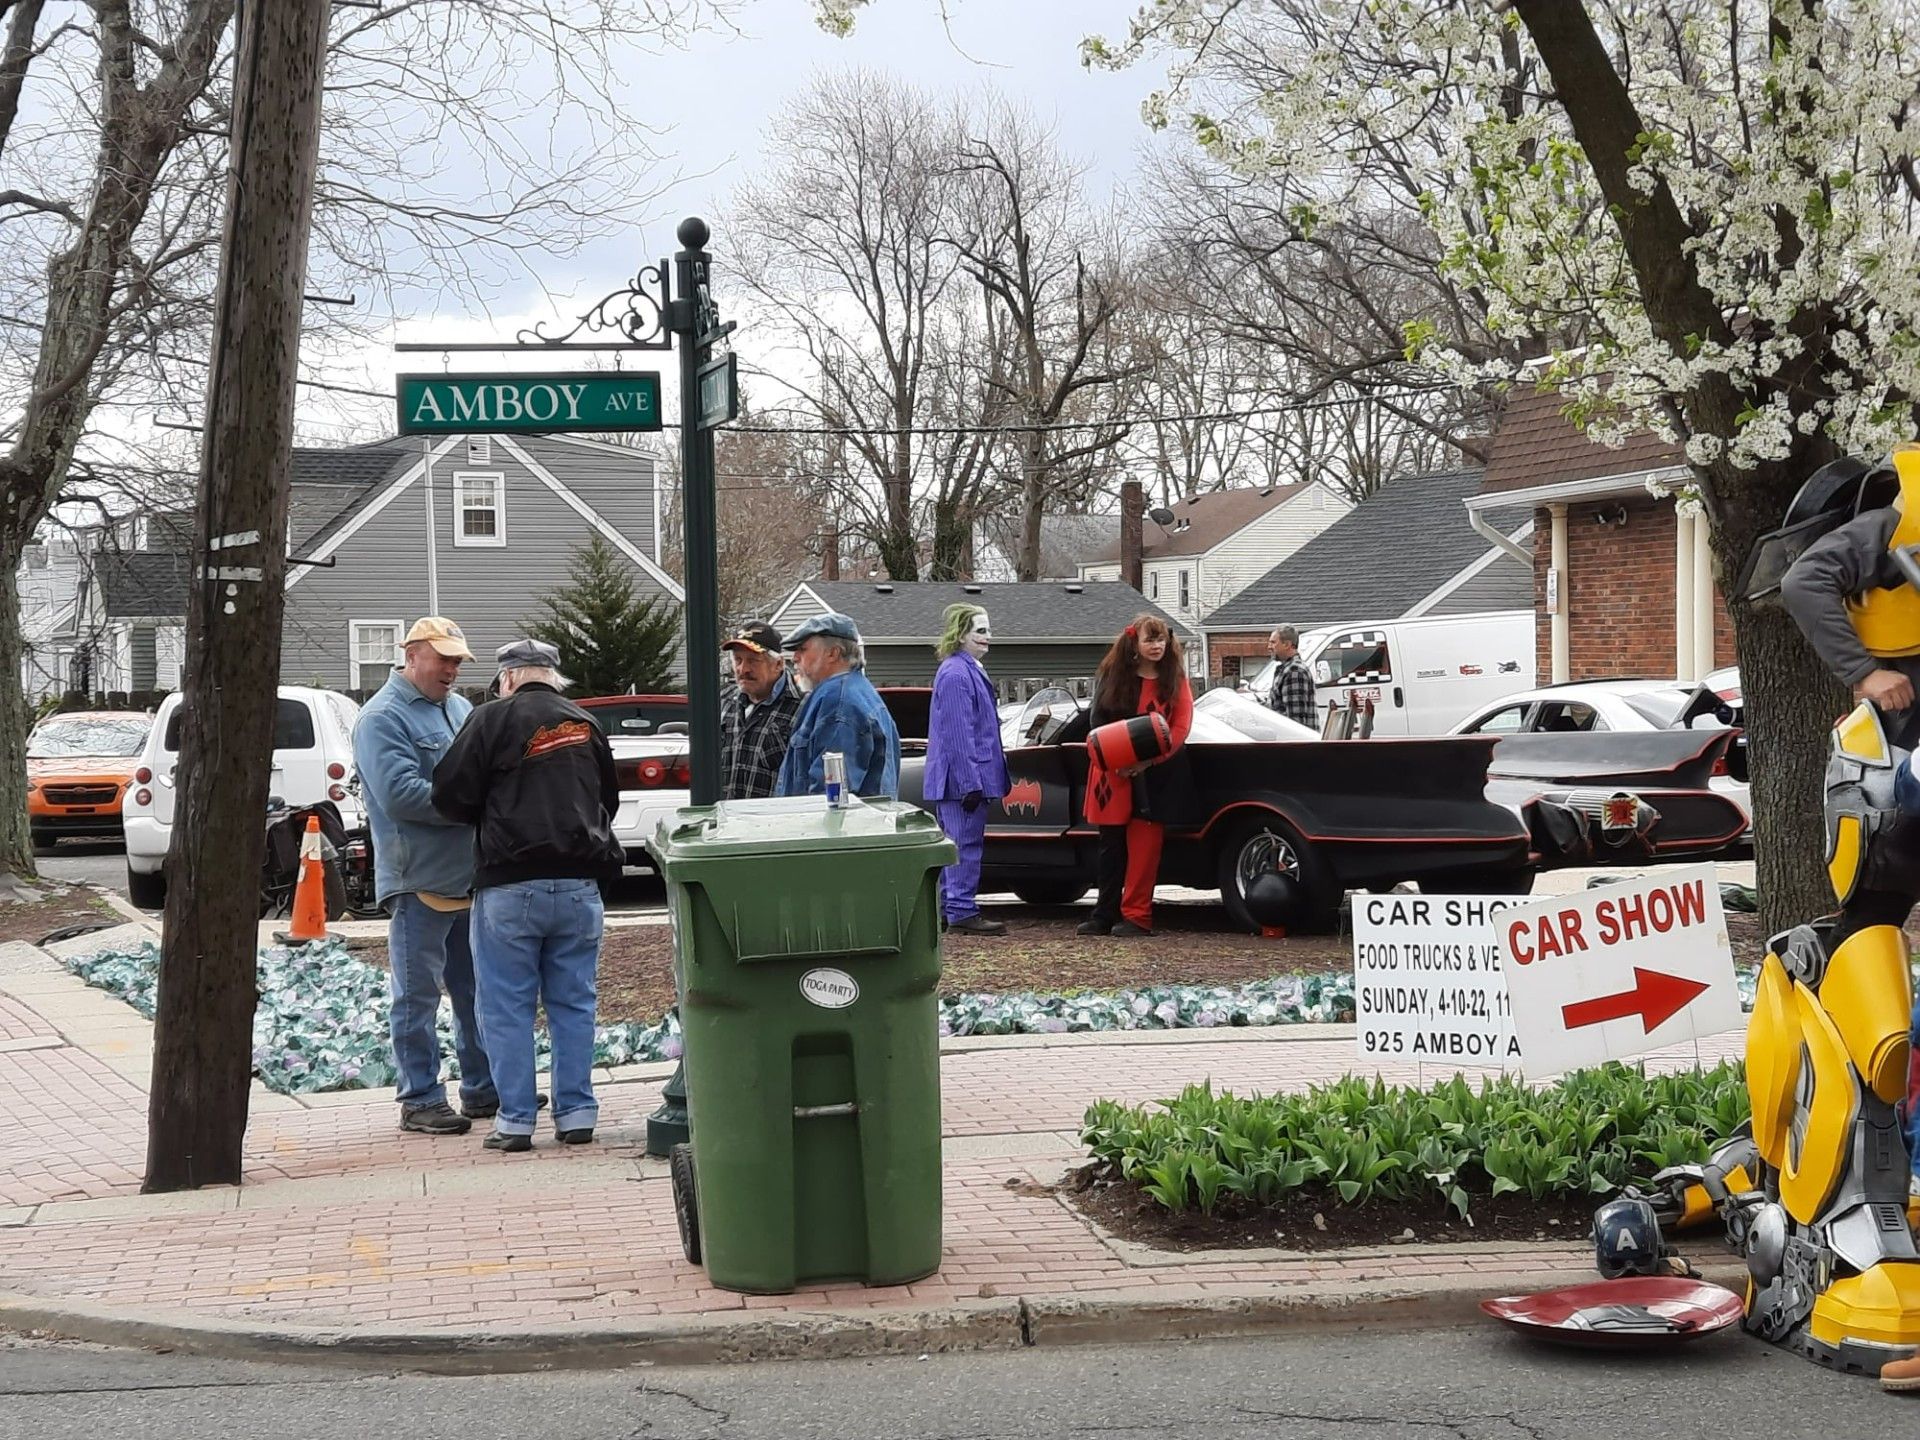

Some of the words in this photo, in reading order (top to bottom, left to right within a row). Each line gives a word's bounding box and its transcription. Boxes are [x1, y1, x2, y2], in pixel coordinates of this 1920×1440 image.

[412, 384, 588, 422] AMBOY
[604, 392, 649, 411] AVE
[1367, 900, 1431, 926] CAR
[1445, 900, 1529, 926] SH
[1508, 908, 1589, 965] CAR
[1595, 879, 1705, 945] SHOW
[1358, 944, 1398, 970] FOOD
[1403, 944, 1462, 971] TRUCKS
[1467, 945, 1477, 971] &
[805, 978, 827, 993] TOGA
[828, 983, 854, 998] PARTY
[1362, 987, 1434, 1021] SUNDAY,
[1438, 988, 1491, 1023] 4-10-22,
[1365, 1031, 1404, 1053] 925
[1412, 1032, 1498, 1056] AMBOY
[1616, 1227, 1639, 1252] A
